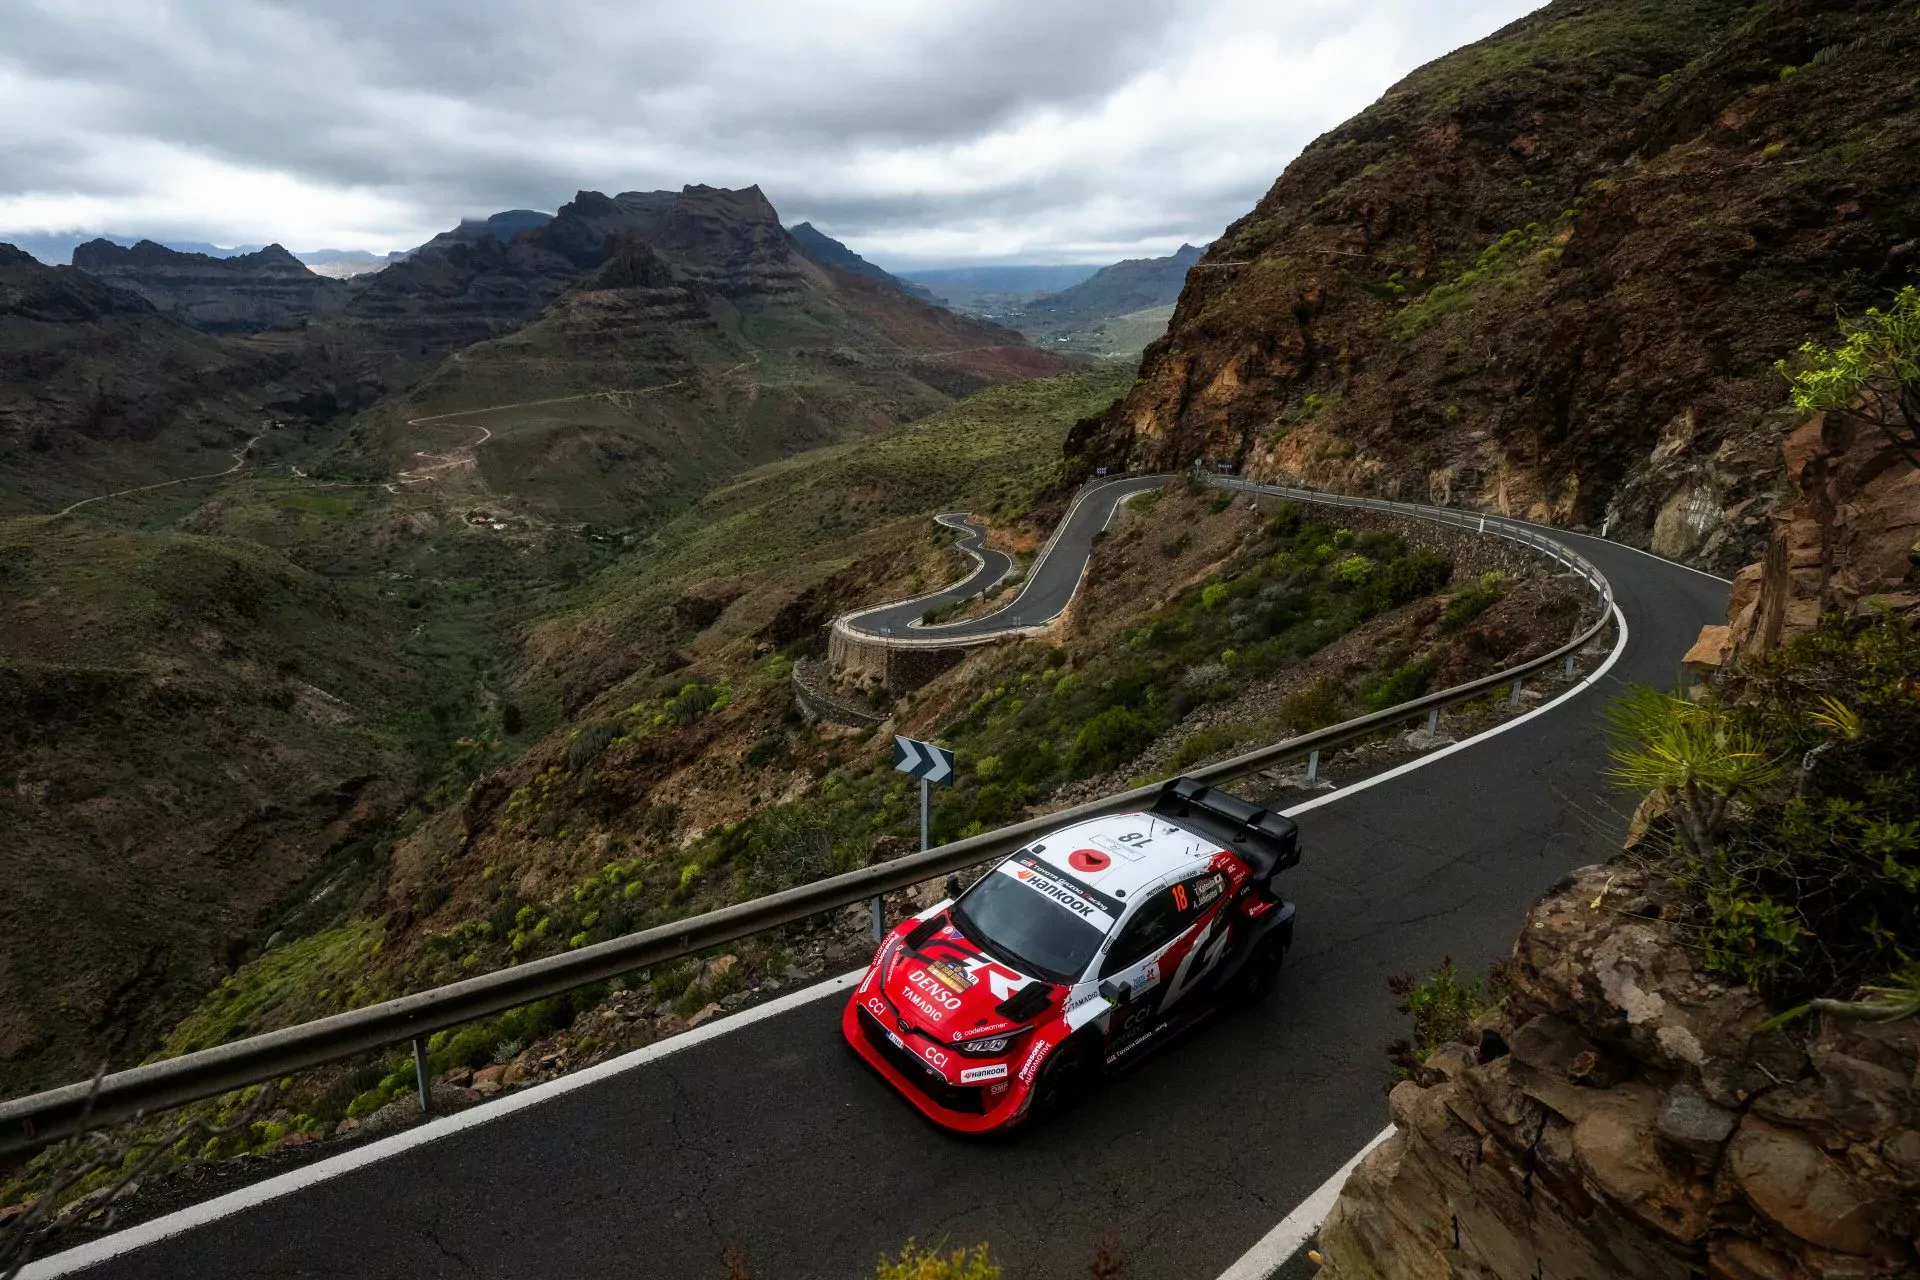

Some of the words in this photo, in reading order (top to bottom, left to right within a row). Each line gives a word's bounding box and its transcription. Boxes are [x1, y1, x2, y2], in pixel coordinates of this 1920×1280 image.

[1118, 832, 1153, 848] 18
[1034, 865, 1059, 881] TOYOTA
[1058, 878, 1083, 894] GAZOO
[1083, 891, 1108, 911] Racing
[1171, 883, 1188, 912] 18
[901, 986, 942, 1022] TAMADIC
[907, 969, 962, 1011] DENSO
[1071, 991, 1098, 1010] TAMADIC
[963, 1022, 1008, 1037] codebeamer
[1018, 1039, 1045, 1081] Panasonic
[1024, 1042, 1052, 1085] AUTOMOTIVE
[1116, 1042, 1135, 1056] TOYOTA
